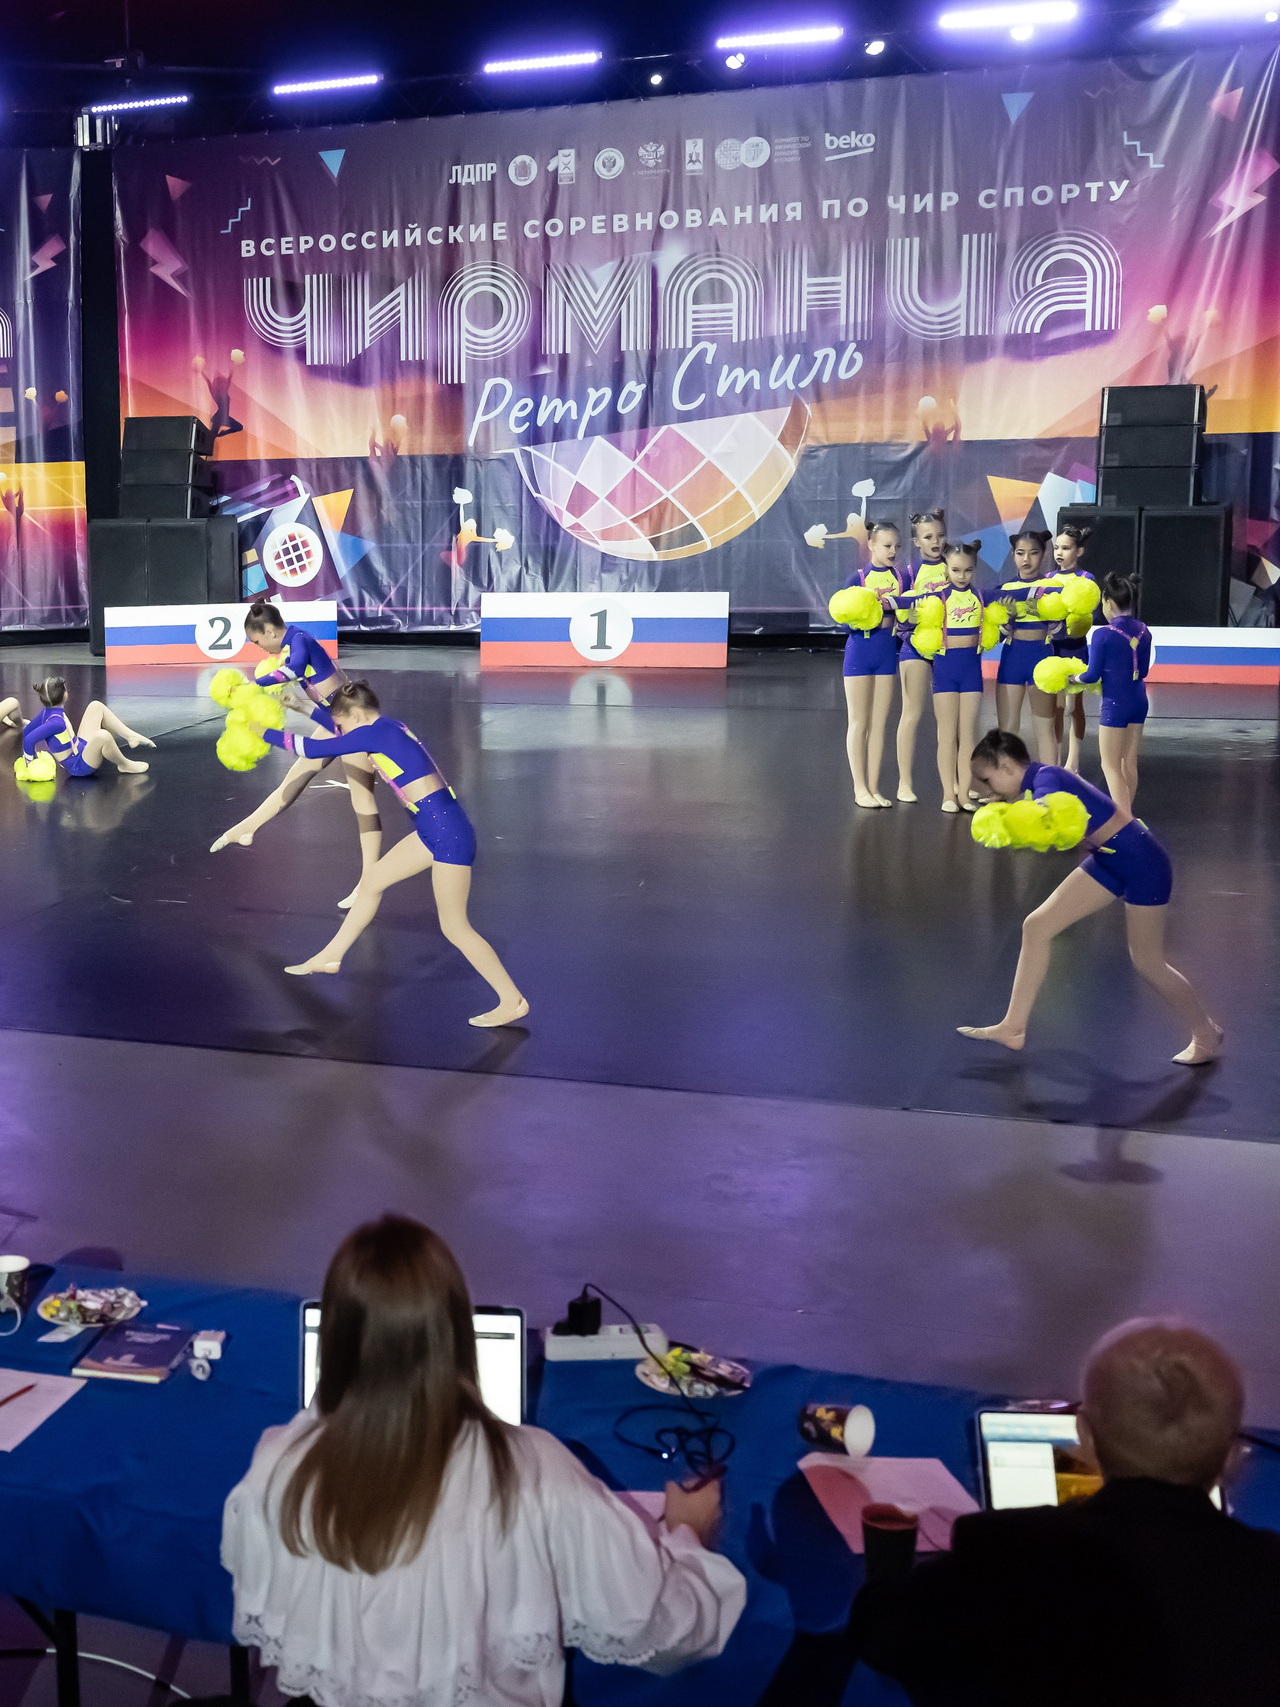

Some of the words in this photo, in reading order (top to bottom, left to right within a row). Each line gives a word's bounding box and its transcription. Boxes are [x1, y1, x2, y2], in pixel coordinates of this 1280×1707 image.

[824, 130, 876, 150] beko
[448, 162, 497, 186] ЛДПР
[240, 221, 509, 258] ВСЕРОССИЙСКИЕ
[523, 201, 803, 239] СОРЕВНОВАНИЯ
[822, 196, 870, 219] ПО
[887, 191, 960, 215] ЧИР
[977, 179, 1130, 210] СПОРТУ
[467, 376, 647, 447] Ретро
[671, 341, 864, 411] Стиль
[207, 616, 233, 651] 2
[589, 608, 614, 650] 1
